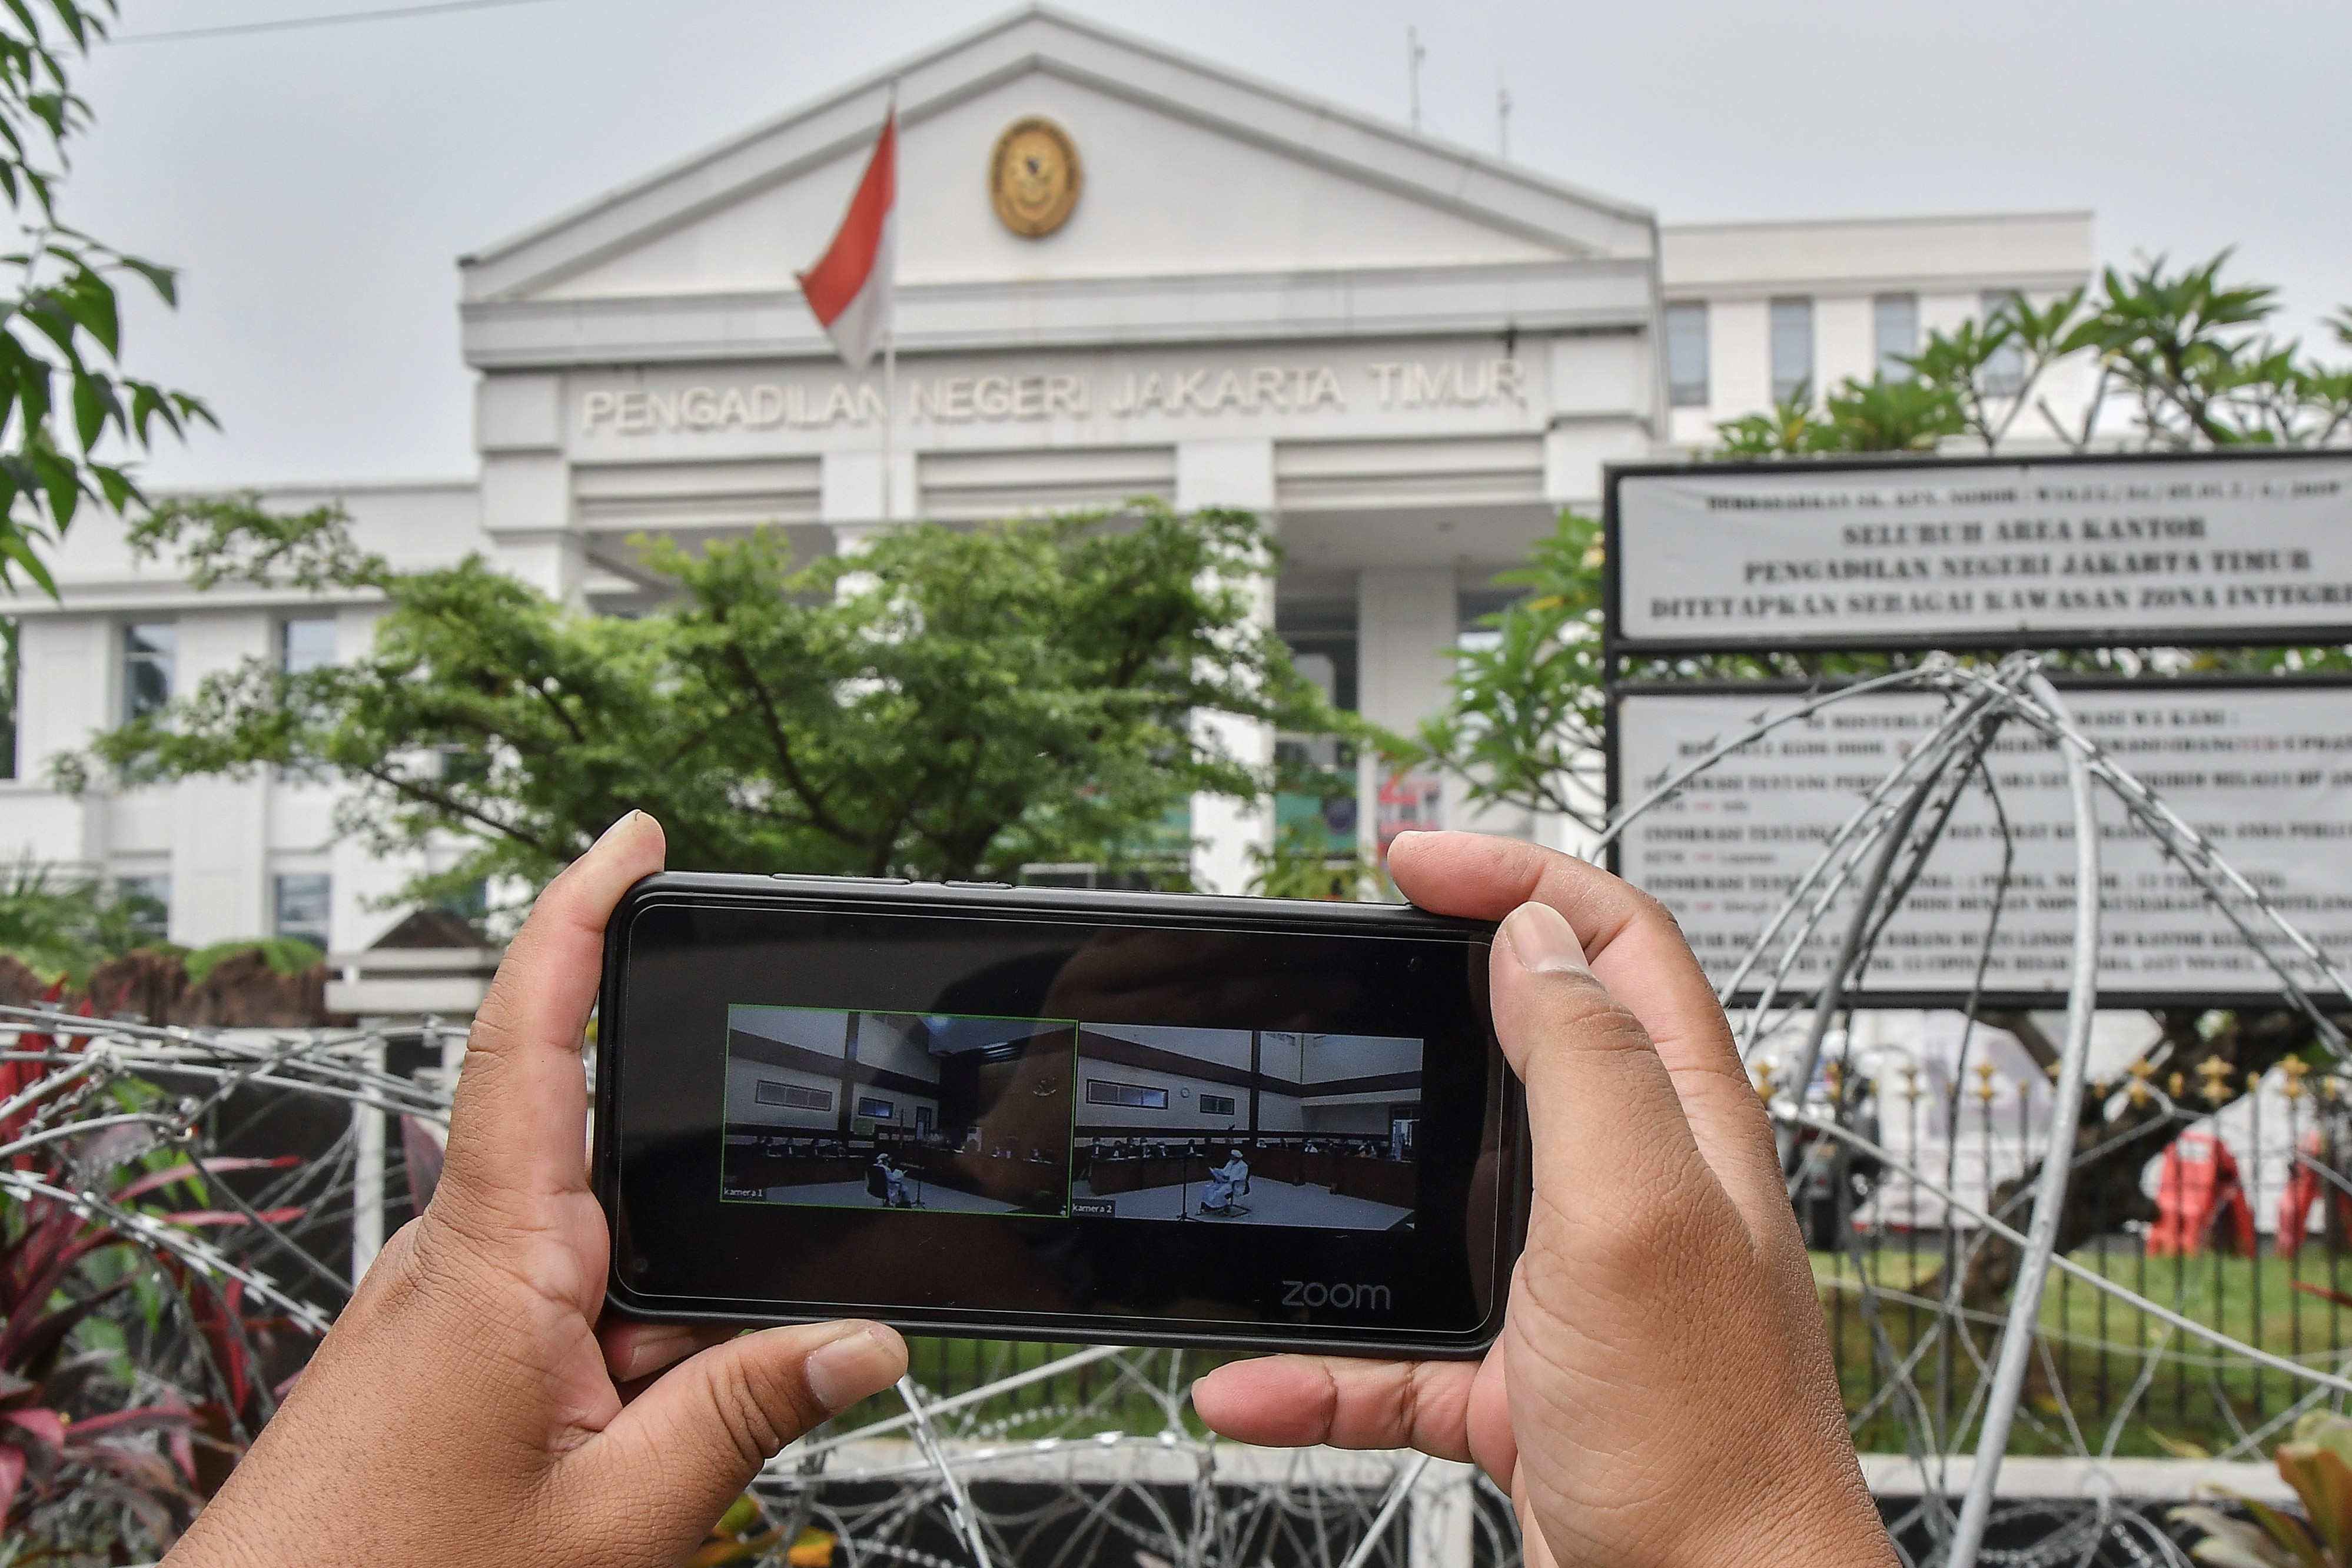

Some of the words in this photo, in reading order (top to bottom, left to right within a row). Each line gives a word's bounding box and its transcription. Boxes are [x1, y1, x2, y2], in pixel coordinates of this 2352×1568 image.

[583, 381, 890, 432] PENGADILAN
[909, 372, 1090, 421] NEGERI
[1110, 365, 1347, 414] JAKARTA
[1370, 357, 1528, 407] TIMUR
[724, 1187, 756, 1197] kamera
[1072, 1203, 1105, 1213] kamera
[1107, 1205, 1112, 1213] 2
[1281, 1280, 1391, 1310] zoom
